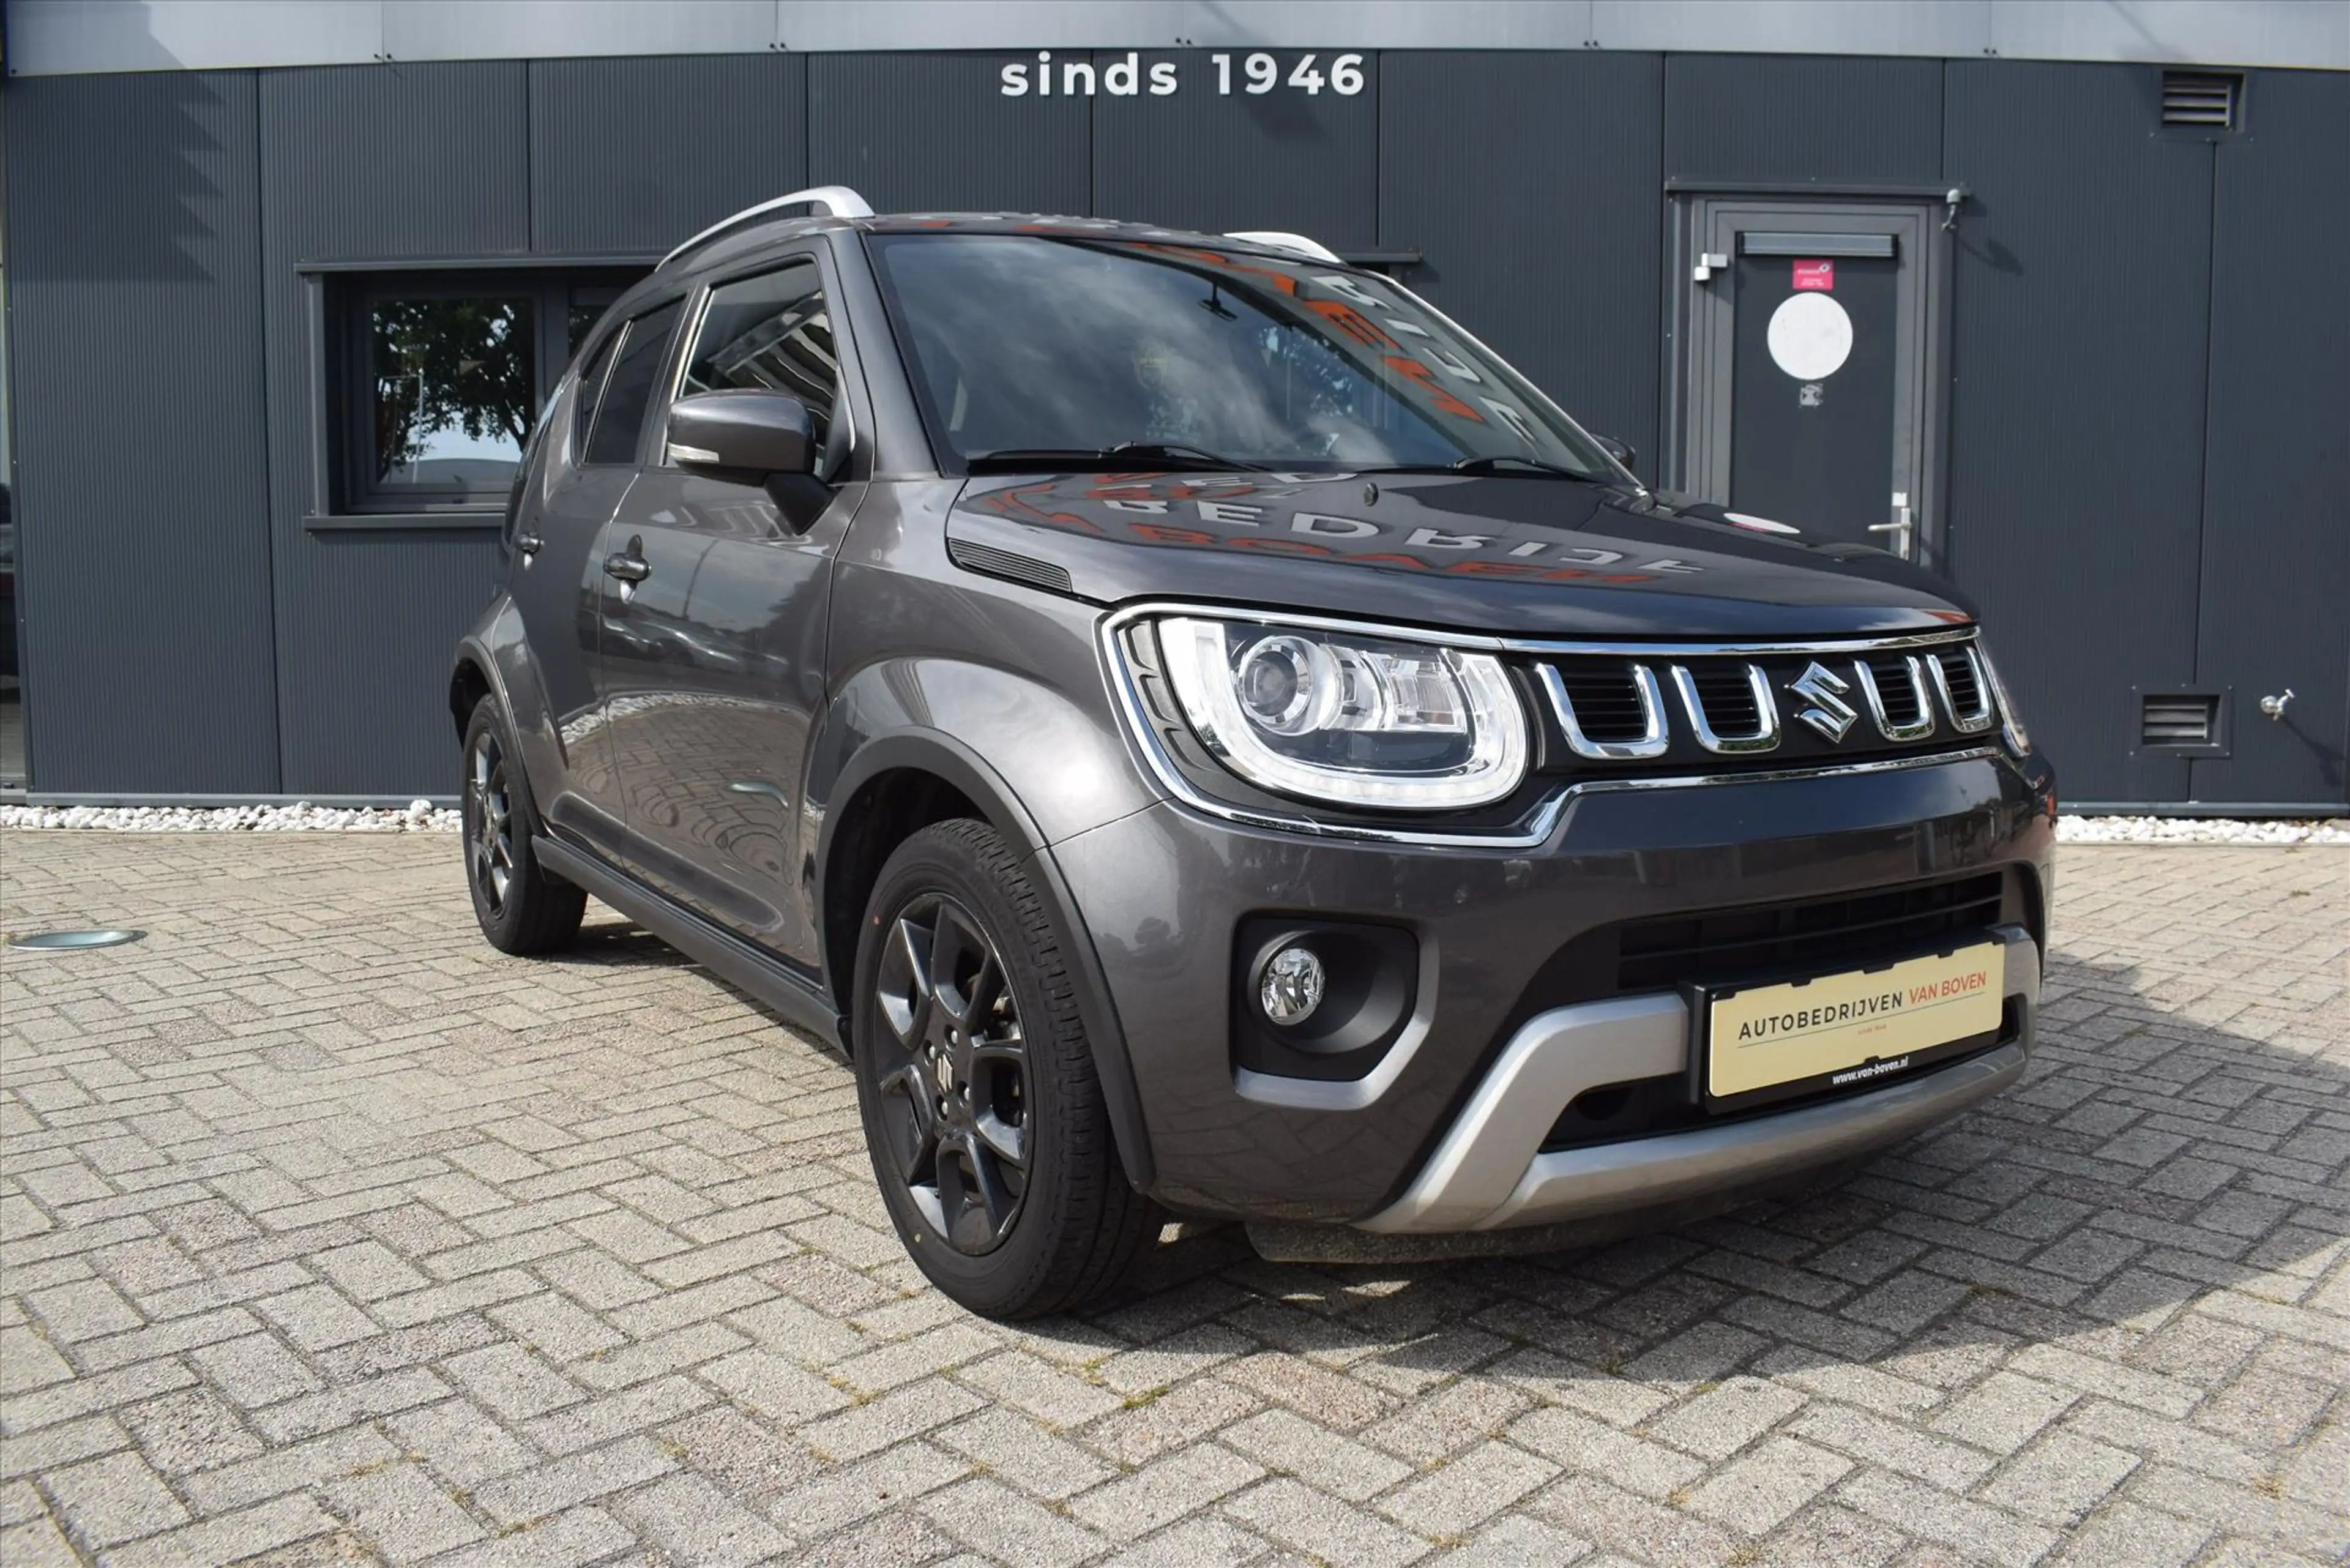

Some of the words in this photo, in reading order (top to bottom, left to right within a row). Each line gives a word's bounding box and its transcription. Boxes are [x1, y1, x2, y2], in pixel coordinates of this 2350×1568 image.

[1001, 51, 1177, 96] sinds
[1212, 53, 1365, 95] 1946
[1738, 991, 1903, 1040] AUTOBEDRIJVEN
[1909, 981, 1938, 1005] VAN
[1941, 971, 1986, 996] BOVEN
[1832, 1056, 1909, 1085] www.van-boven.nl
